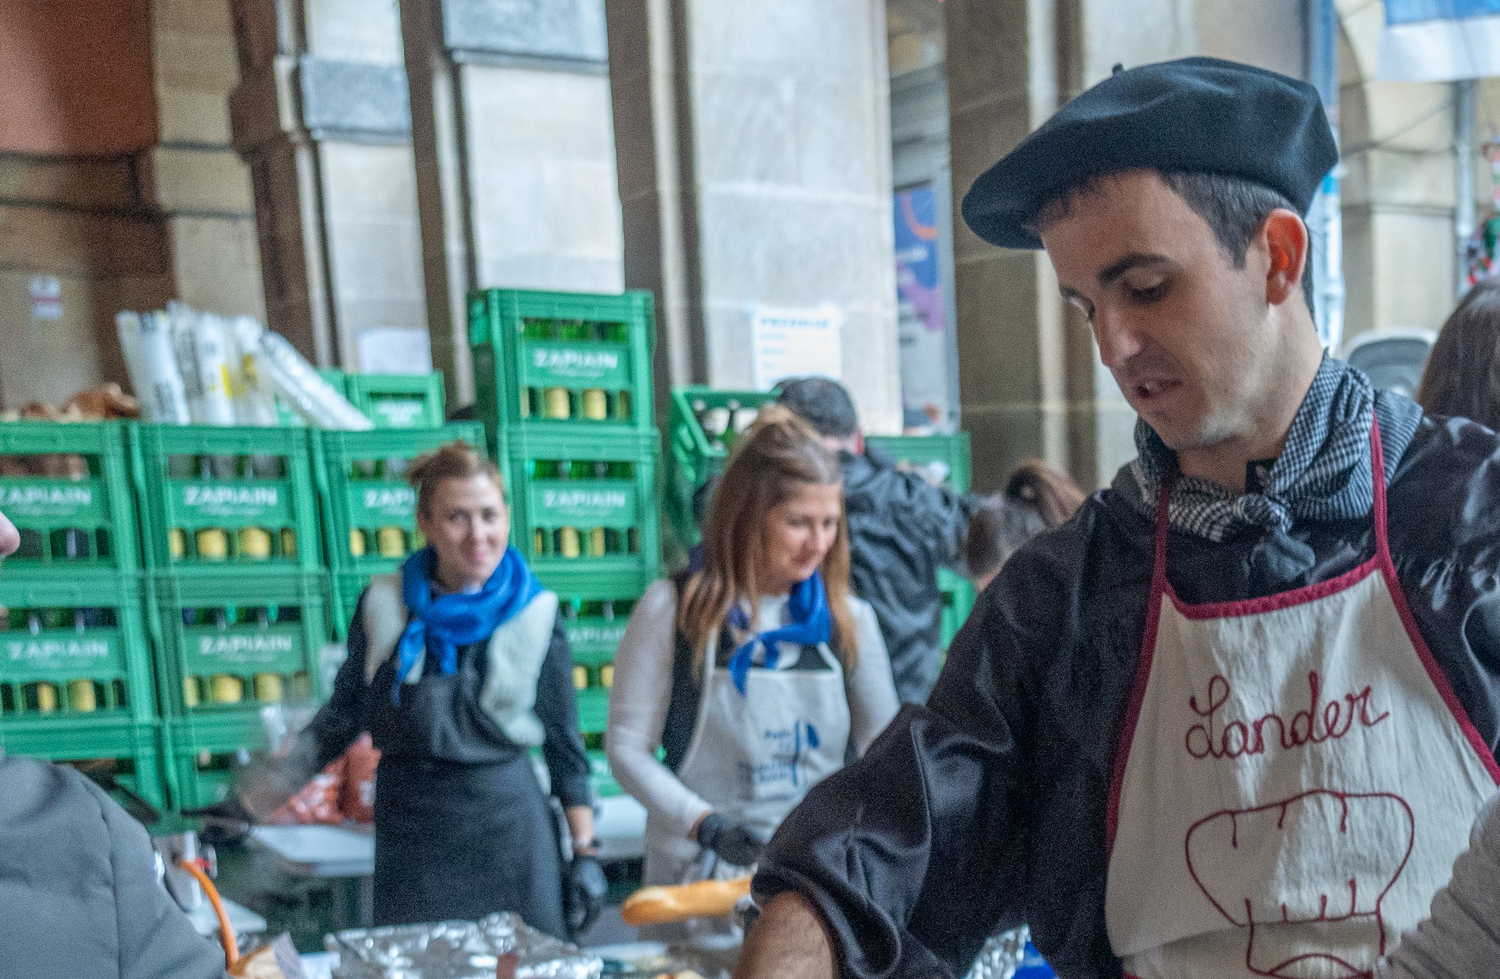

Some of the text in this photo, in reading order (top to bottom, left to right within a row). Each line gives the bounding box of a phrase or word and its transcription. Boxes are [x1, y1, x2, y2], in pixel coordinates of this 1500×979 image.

[534, 348, 618, 369] ZAPIAIN
[184, 486, 278, 506] ZAPIAIN
[544, 488, 626, 508] ZAPIAIN
[8, 639, 109, 660] ZAPIAIN
[200, 636, 293, 658] ZAPIAIN
[1185, 670, 1390, 760] Lander
